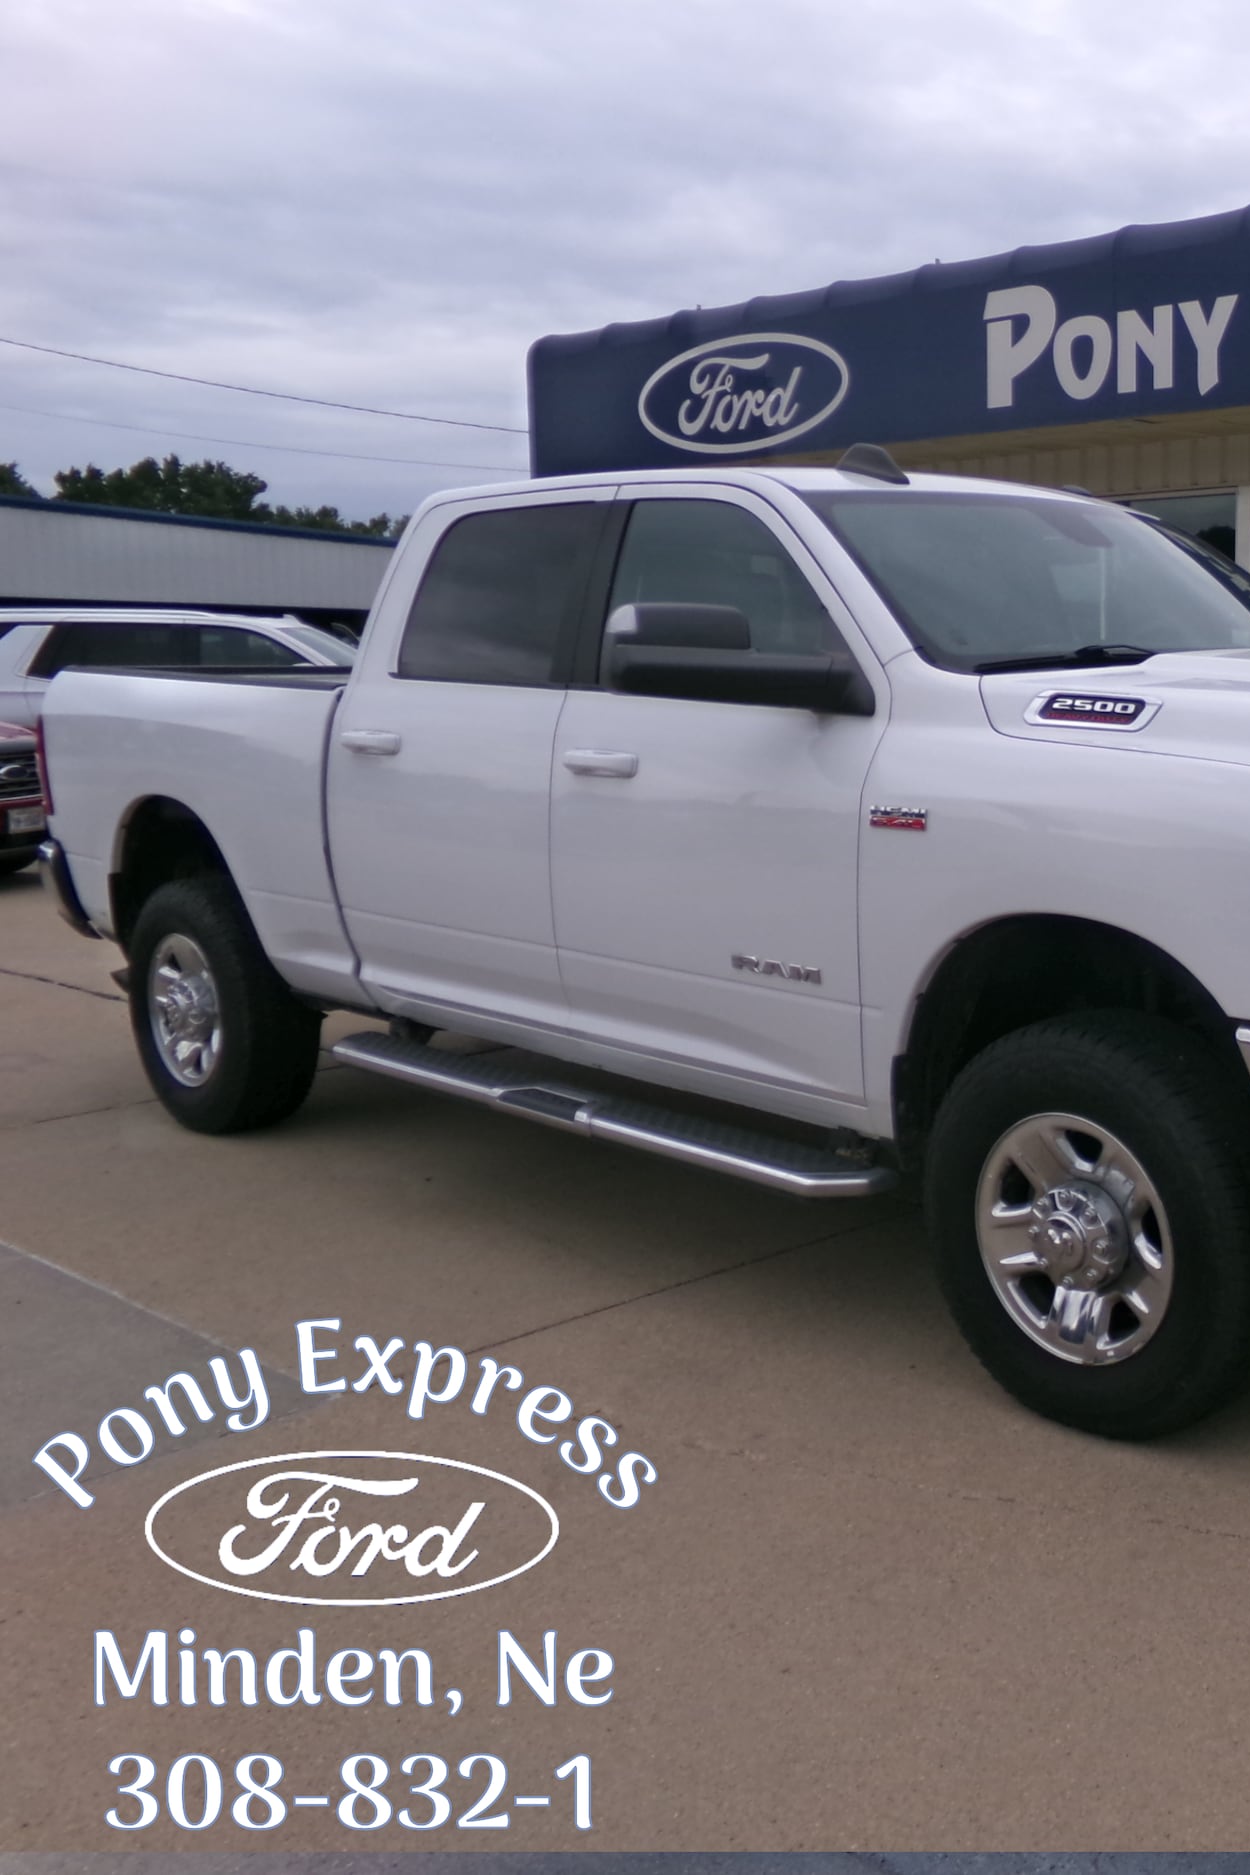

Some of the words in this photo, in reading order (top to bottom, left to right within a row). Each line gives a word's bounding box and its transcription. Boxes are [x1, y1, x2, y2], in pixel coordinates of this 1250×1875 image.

[983, 285, 1239, 409] PONY
[677, 352, 803, 437] Ford
[1052, 698, 1136, 714] 2500
[731, 954, 822, 984] RAM
